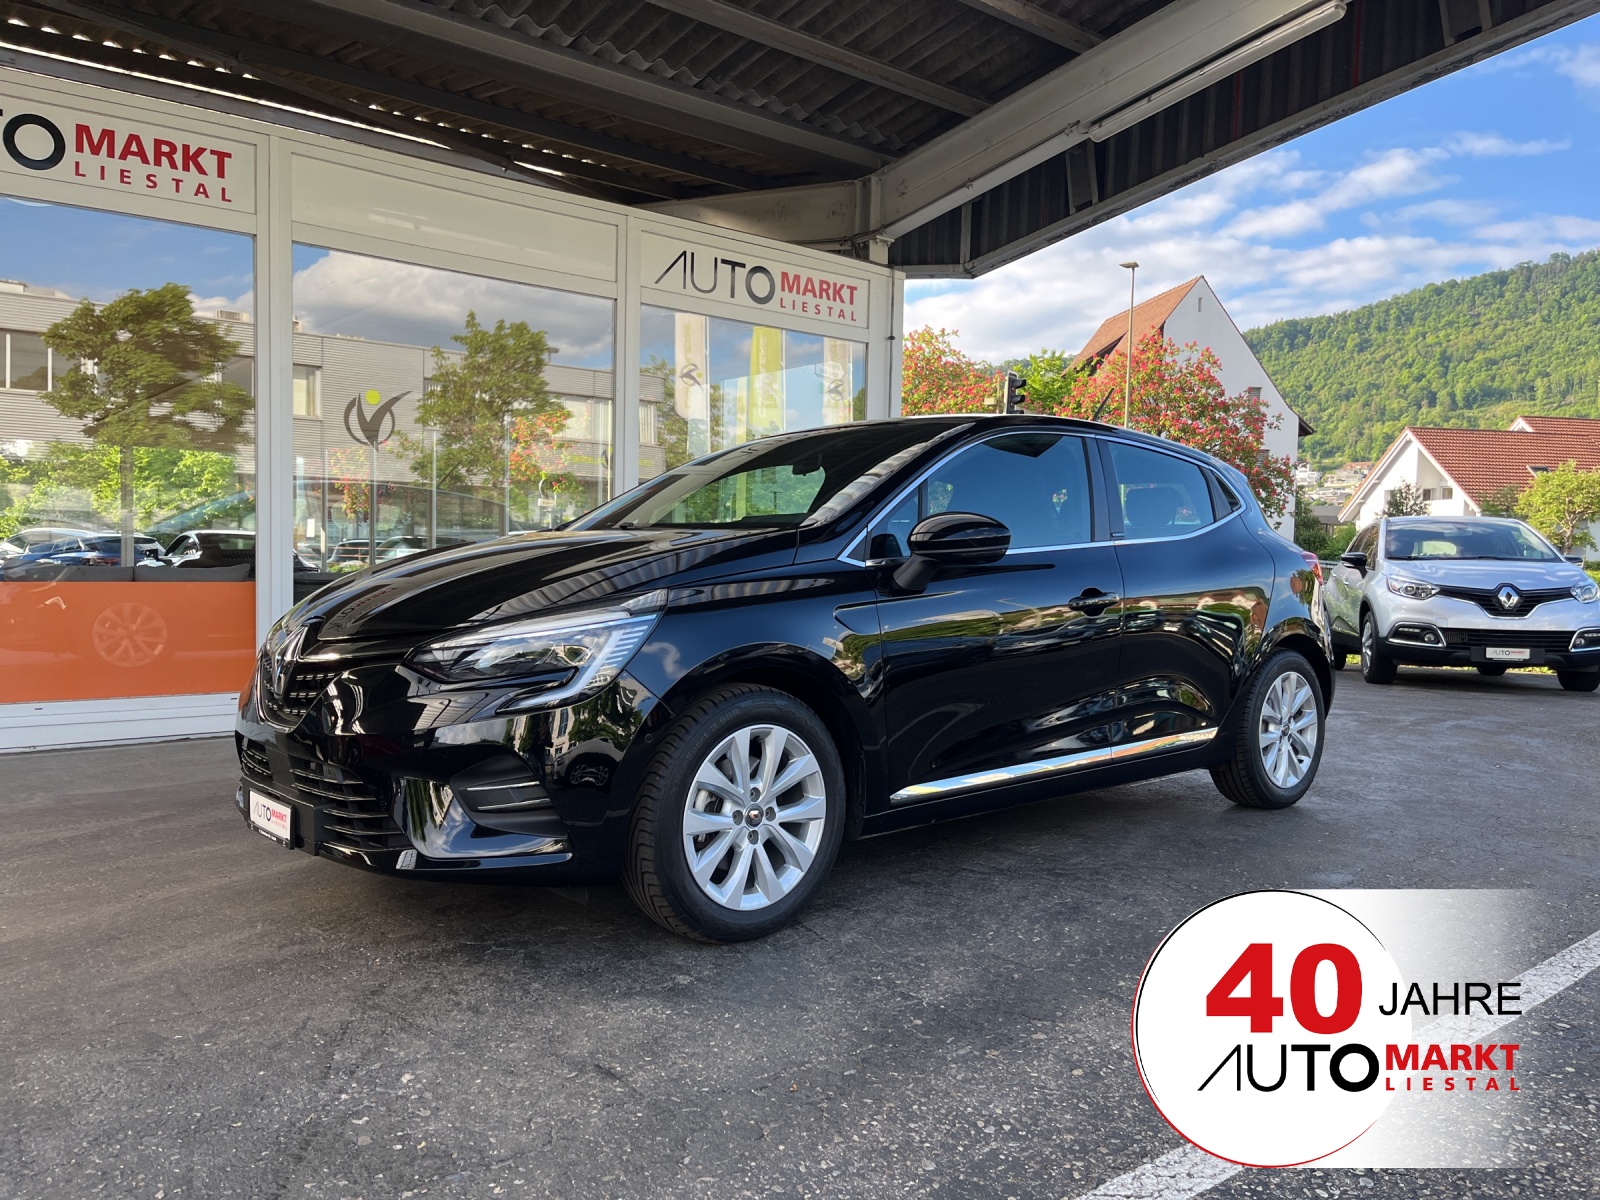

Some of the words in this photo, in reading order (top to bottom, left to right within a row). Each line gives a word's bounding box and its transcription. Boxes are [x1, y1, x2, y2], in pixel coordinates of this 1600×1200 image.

[0, 108, 66, 171] O
[75, 123, 232, 179] MARKT
[74, 161, 232, 203] LIESTAL
[654, 250, 776, 305] AUTO
[780, 271, 857, 305] MARKT
[779, 297, 857, 322] LIESTAL
